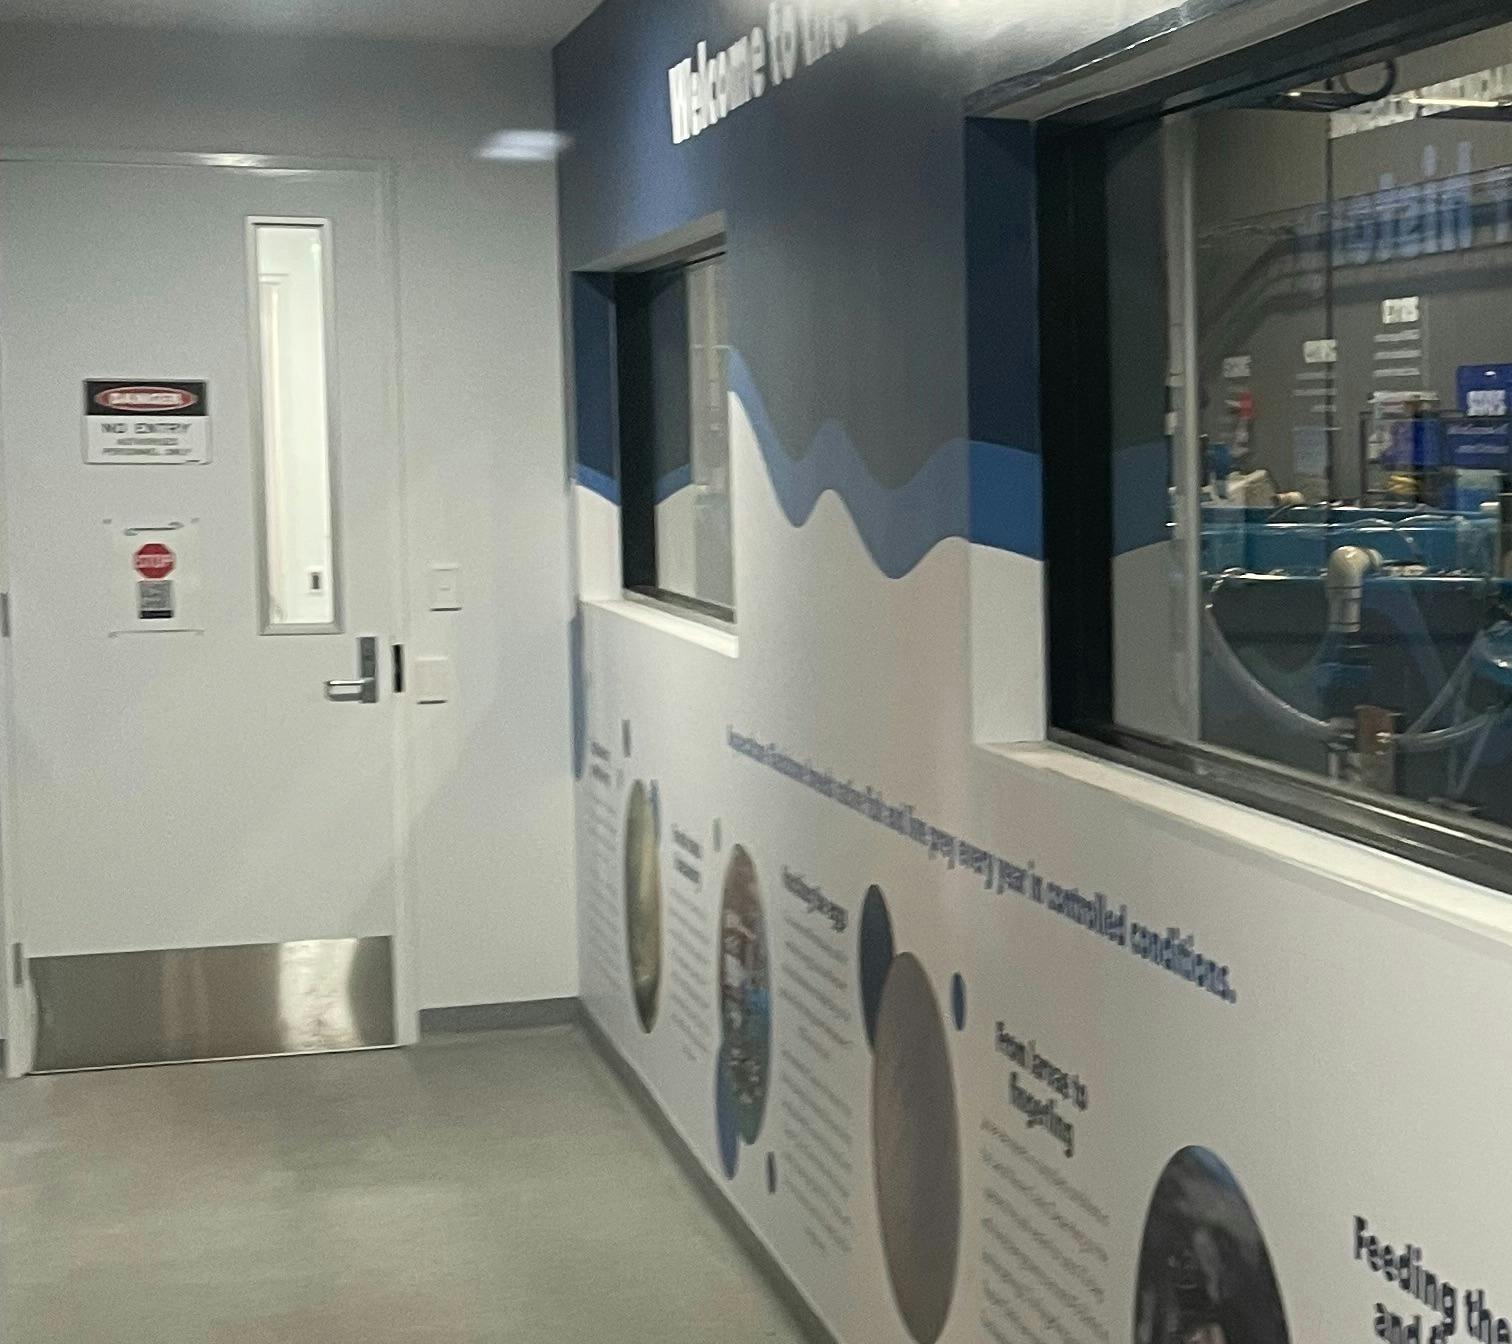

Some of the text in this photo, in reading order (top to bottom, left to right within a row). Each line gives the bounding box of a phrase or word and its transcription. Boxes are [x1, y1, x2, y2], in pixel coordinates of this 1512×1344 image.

[668, 26, 766, 145] Welcome
[768, 2, 799, 87] to
[1131, 922, 1237, 1004] conditions.
[1353, 1214, 1456, 1337] Feeding
